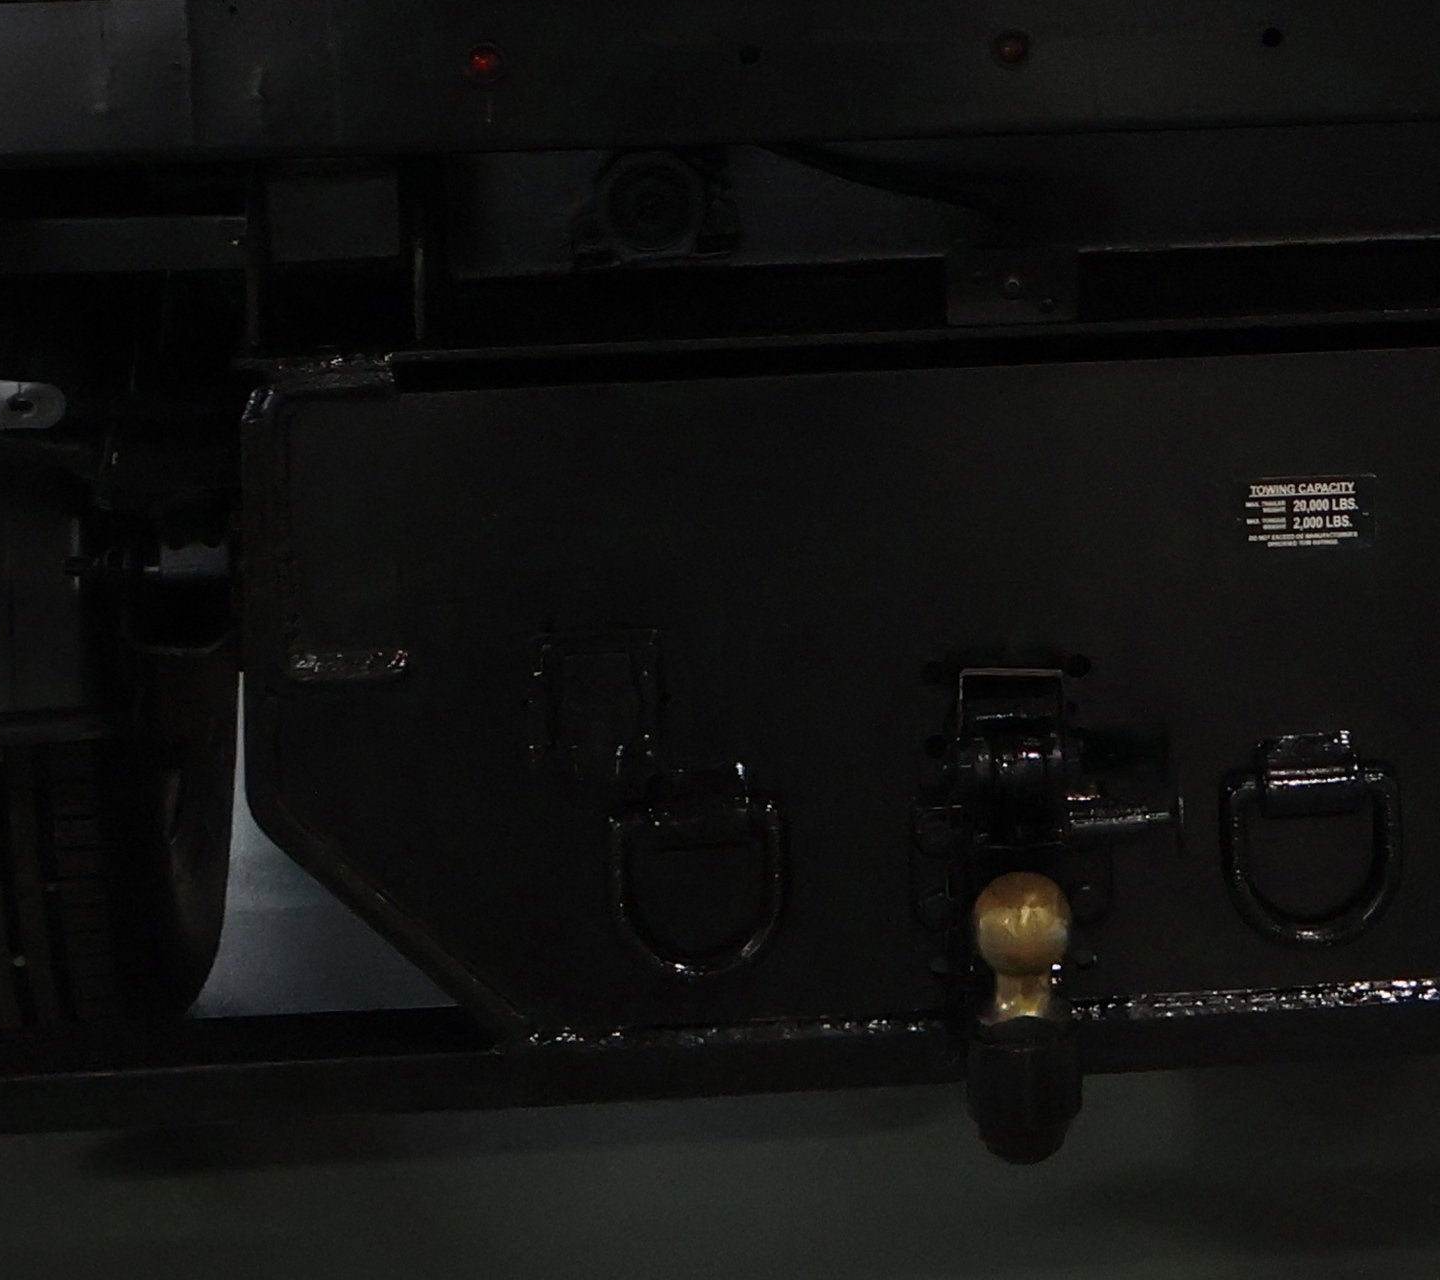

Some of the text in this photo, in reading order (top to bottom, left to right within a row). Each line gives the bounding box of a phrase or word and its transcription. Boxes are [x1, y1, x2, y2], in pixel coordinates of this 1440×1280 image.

[1249, 482, 1355, 496] TOWING CAPACITY
[1293, 498, 1330, 514] 20,000
[1332, 498, 1359, 511] LBS.
[1293, 516, 1323, 531] 2,000
[1325, 515, 1353, 528] LBS.
